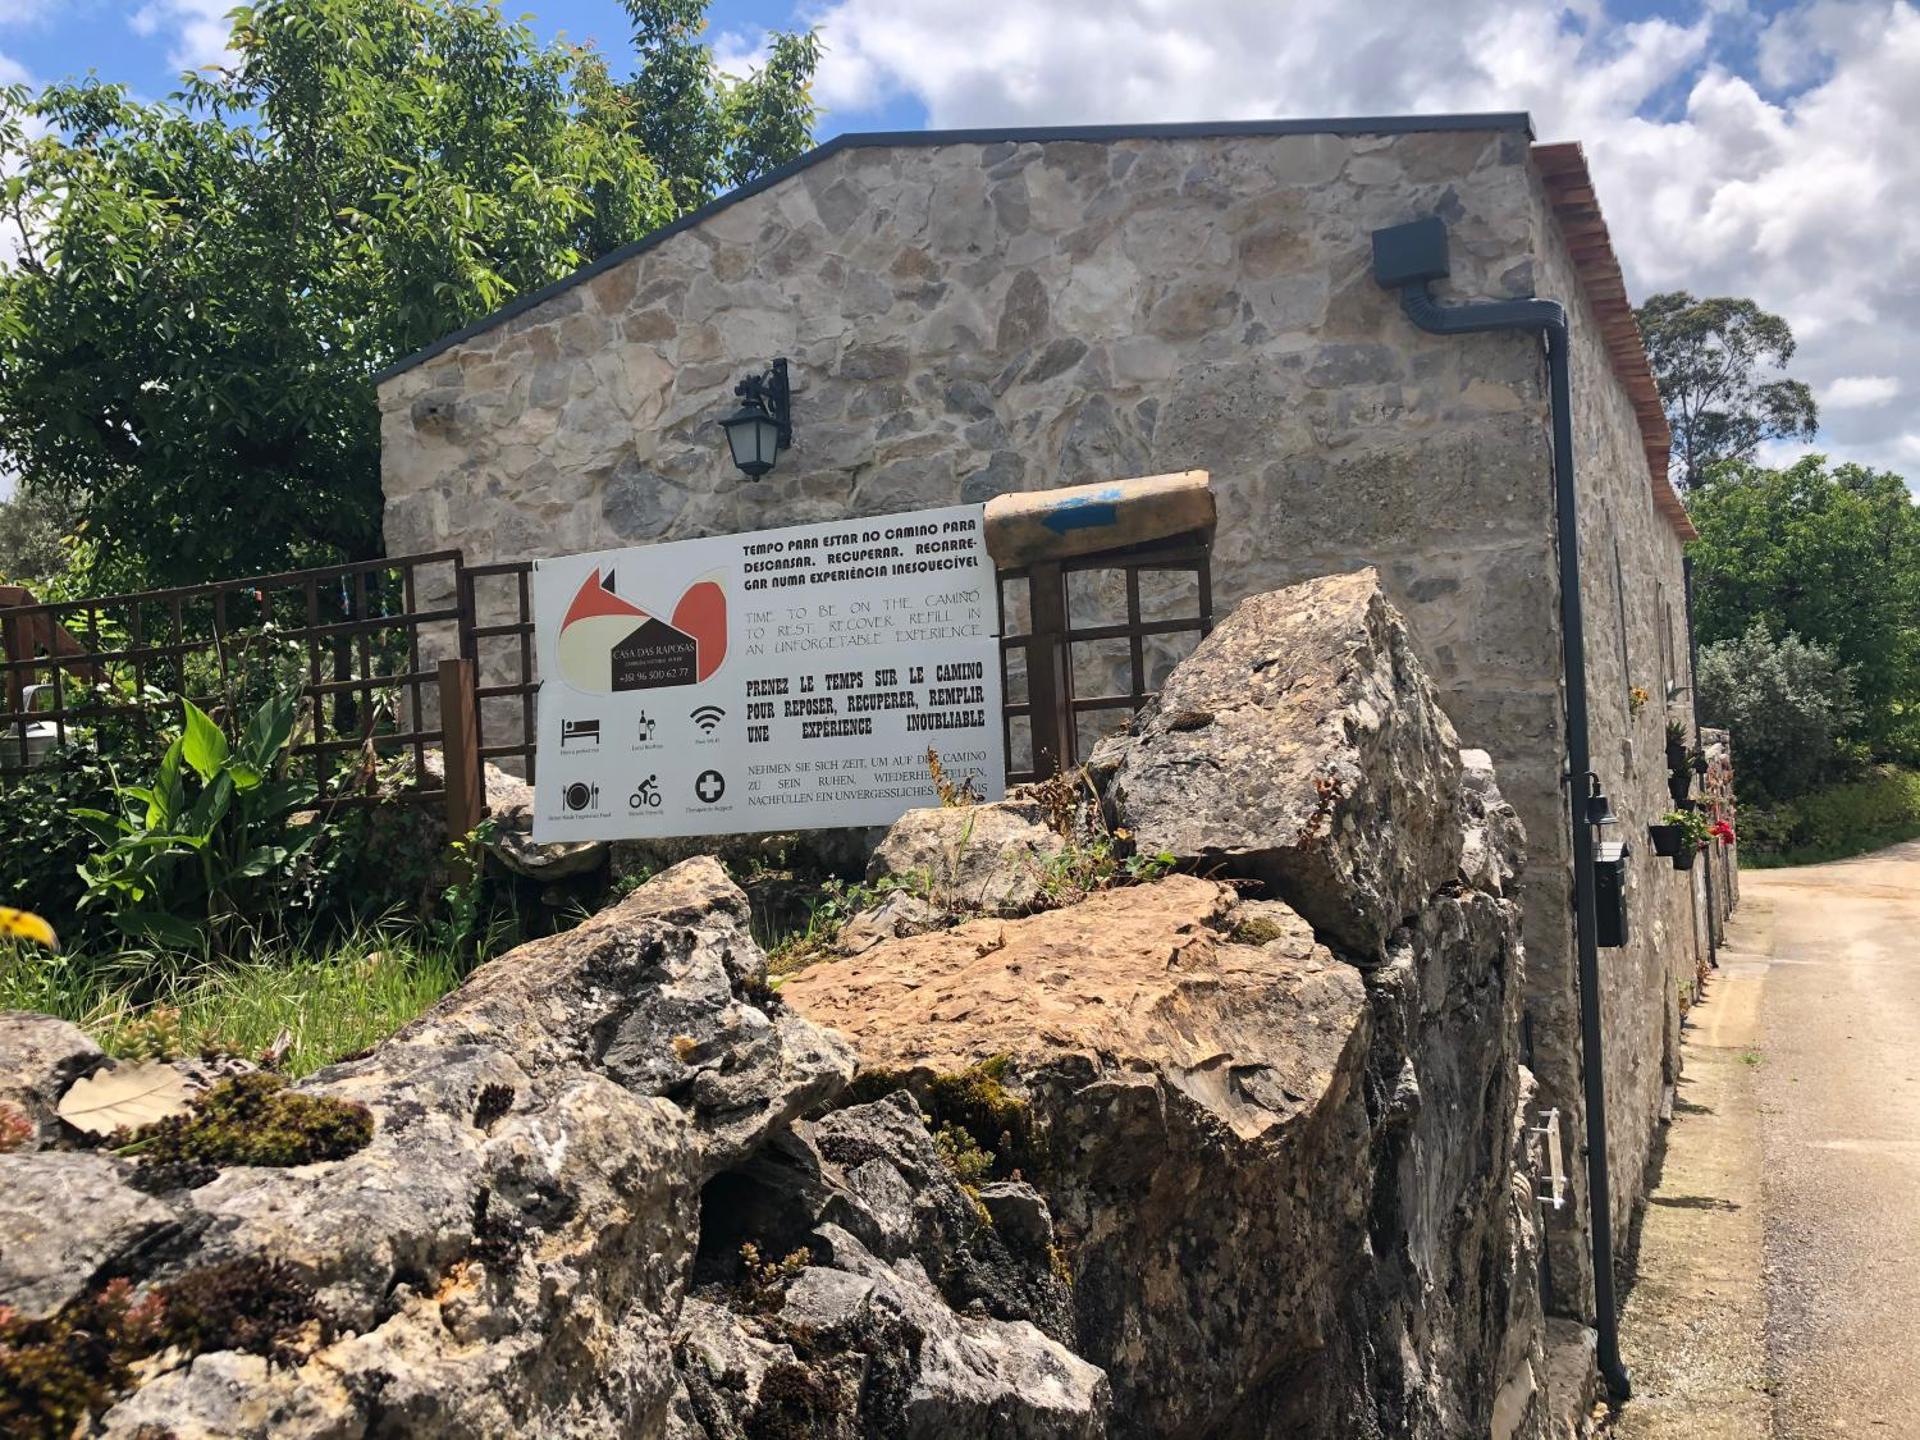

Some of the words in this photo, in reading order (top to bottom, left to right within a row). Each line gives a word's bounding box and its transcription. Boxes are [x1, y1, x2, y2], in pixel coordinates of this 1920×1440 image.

[743, 542, 784, 556] TEMPO
[788, 538, 819, 551] PARA
[823, 534, 858, 548] ESTAR
[862, 531, 881, 542] NO
[885, 524, 938, 540] CAMINO
[943, 520, 976, 533] PARA
[916, 539, 977, 555] RECARRE-
[744, 577, 768, 591] GAR
[772, 574, 806, 588] NUMA
[892, 555, 979, 576] INESQUECÍVEL
[746, 611, 775, 624] TIME
[787, 607, 807, 620] TO
[818, 605, 836, 618] BE
[850, 602, 870, 614] ON
[883, 597, 912, 610] THE
[925, 590, 980, 607] CAMINO
[747, 627, 765, 639] TO
[910, 610, 952, 624] REFILL
[968, 607, 981, 620] IN
[613, 649, 635, 660] CASA
[637, 647, 654, 657] DAS
[656, 642, 695, 655] RAPOSAS
[746, 643, 764, 656] AN
[896, 624, 983, 643] EXPERIENCE
[746, 677, 790, 697] PRENEZ
[799, 676, 814, 693] LE
[825, 671, 864, 691] TEMPS
[874, 669, 898, 687] SUR
[909, 666, 924, 684] LE
[936, 662, 983, 682] CAMINO
[746, 702, 775, 720] POUR
[784, 697, 838, 718] REPOSER,
[847, 691, 919, 713] RECUPERER,
[929, 686, 984, 706] REMPLIR
[747, 725, 769, 743] UNE
[802, 716, 872, 739] EXPÉRIENCE
[907, 710, 985, 732] INOUBLIABLE
[747, 763, 791, 776] NEHMEN
[795, 762, 811, 772] SIE
[815, 760, 839, 771] SICH
[871, 757, 888, 767] UM
[893, 755, 913, 766] AUF
[943, 751, 987, 763] CAMINO
[748, 780, 761, 791] ZU
[777, 778, 801, 790] SEIN
[816, 791, 833, 802] EIN
[835, 784, 934, 801] UNVERGESSLICHES
